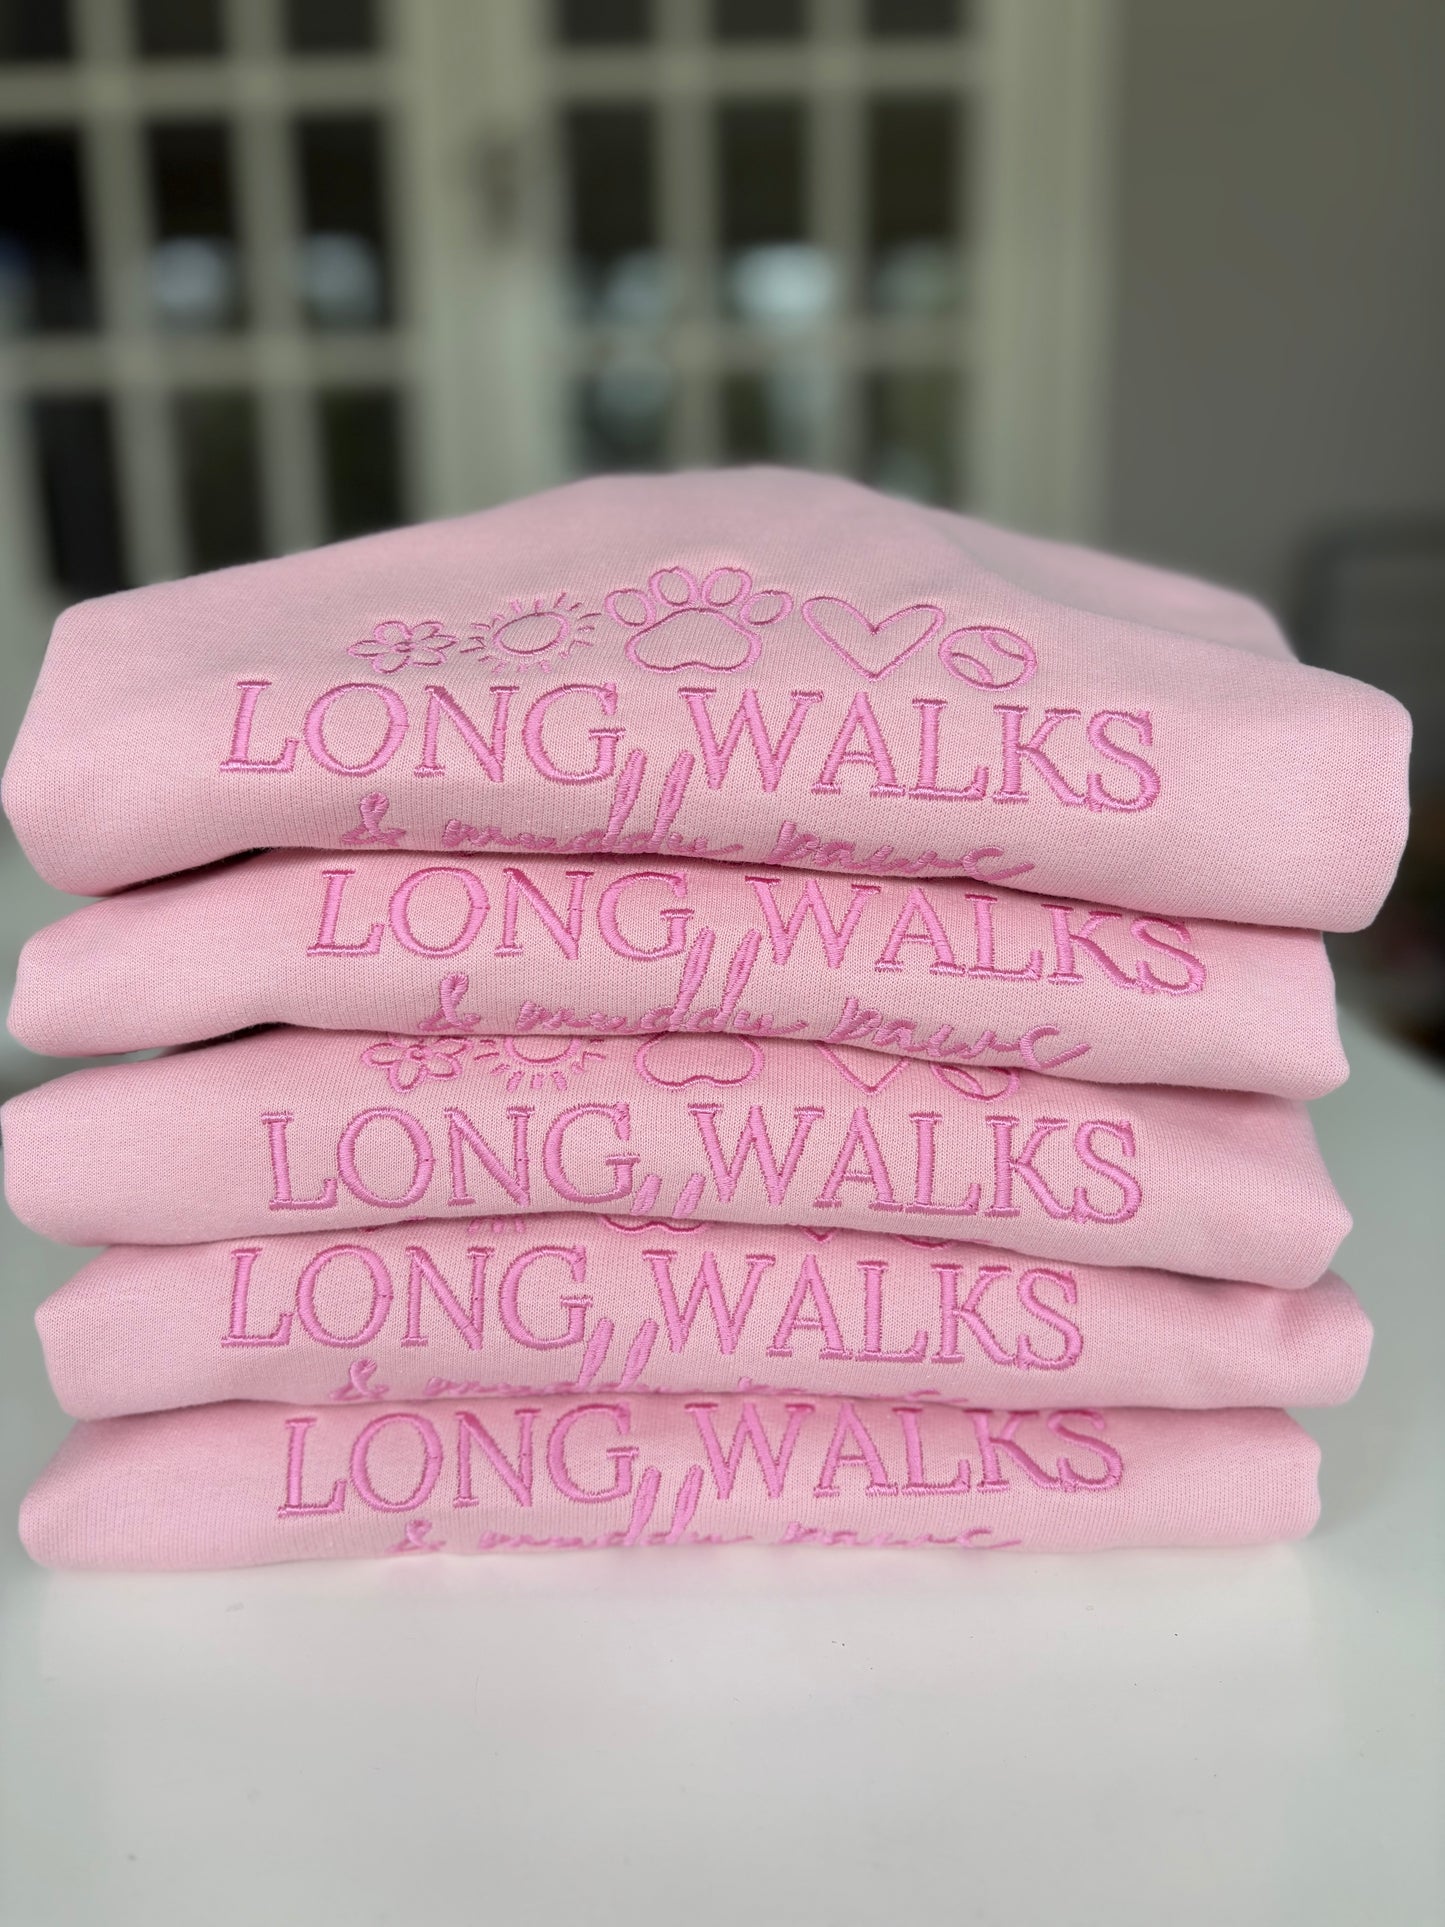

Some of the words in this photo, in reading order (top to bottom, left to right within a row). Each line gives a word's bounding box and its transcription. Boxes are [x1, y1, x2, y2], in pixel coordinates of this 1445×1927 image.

[220, 679, 626, 785] LONG
[678, 687, 1161, 813] WALKS
[342, 792, 406, 845] &
[306, 866, 695, 961] LONG
[744, 875, 1207, 996] WALKS
[419, 972, 480, 1033] &
[260, 1102, 641, 1210] LONG
[687, 1102, 1143, 1224] WALKS
[220, 1244, 594, 1350] LONG
[642, 1249, 1084, 1371] WALKS
[277, 1402, 640, 1519] LONG
[684, 1402, 1125, 1500] WALKS
